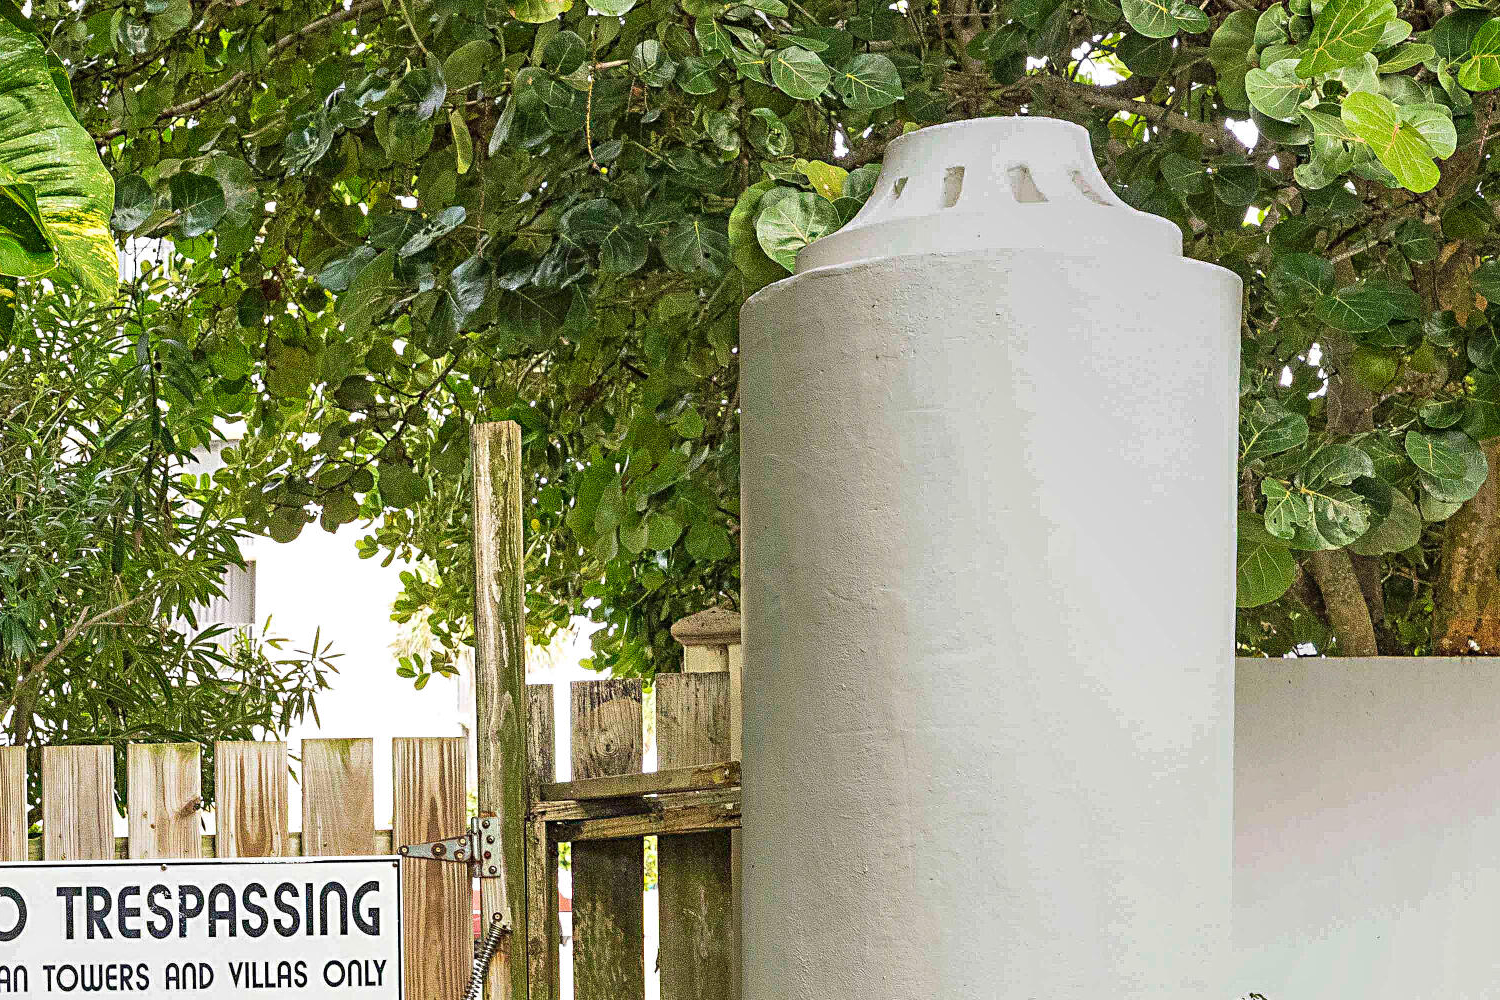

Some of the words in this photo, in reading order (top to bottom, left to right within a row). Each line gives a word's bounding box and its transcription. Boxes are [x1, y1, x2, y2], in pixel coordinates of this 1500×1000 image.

[56, 881, 381, 940] TRESPASSING
[43, 963, 150, 992] TOWERS
[166, 962, 215, 990] AND
[229, 960, 308, 988] VILLAS
[323, 959, 387, 987] ONLY
